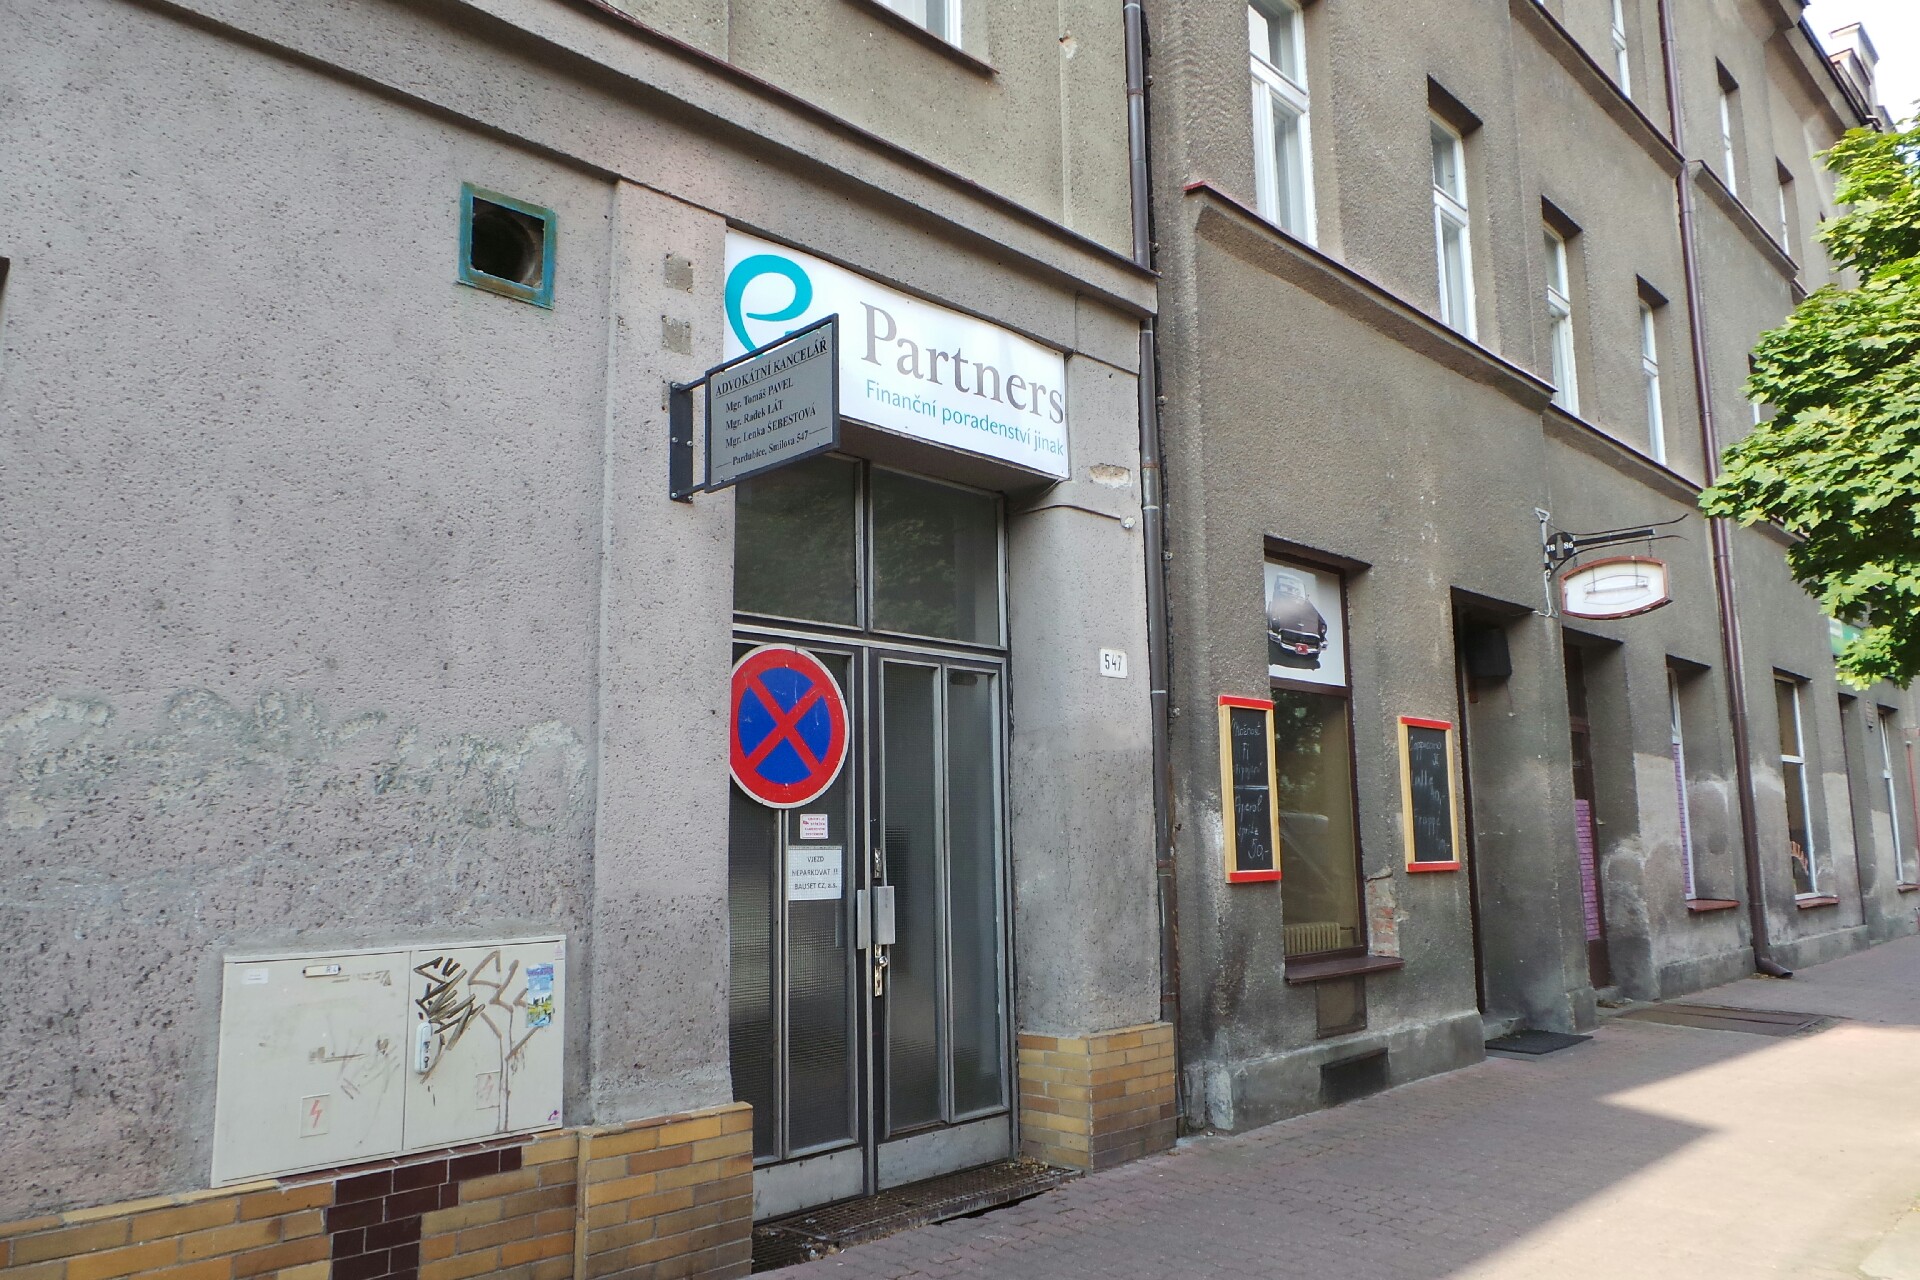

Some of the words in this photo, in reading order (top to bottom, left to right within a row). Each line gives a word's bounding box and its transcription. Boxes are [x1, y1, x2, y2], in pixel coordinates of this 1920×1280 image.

[715, 360, 772, 397] ADVOKÁTNÍ
[773, 336, 828, 374] KANCELÁŘ
[860, 301, 1064, 424] Partners
[725, 402, 742, 414] Mgr.
[744, 389, 766, 405] Tomáš
[768, 378, 794, 396] PAVEL
[725, 419, 742, 431] Mgr.
[743, 407, 766, 424] Radek
[767, 398, 784, 415] LÁT
[725, 437, 742, 449] Mgr.
[743, 427, 766, 442] Lenka
[767, 402, 817, 434] ŠEBESTOVÁ
[866, 379, 937, 418] Finanční
[941, 407, 1031, 445] poradenství
[1034, 430, 1064, 456] jinak
[732, 448, 768, 466] Pardubice,
[768, 437, 795, 454] Smilova
[796, 430, 809, 443] 547
[1546, 544, 1556, 552] 18
[1563, 542, 1574, 550] 86
[1104, 653, 1122, 672] 547
